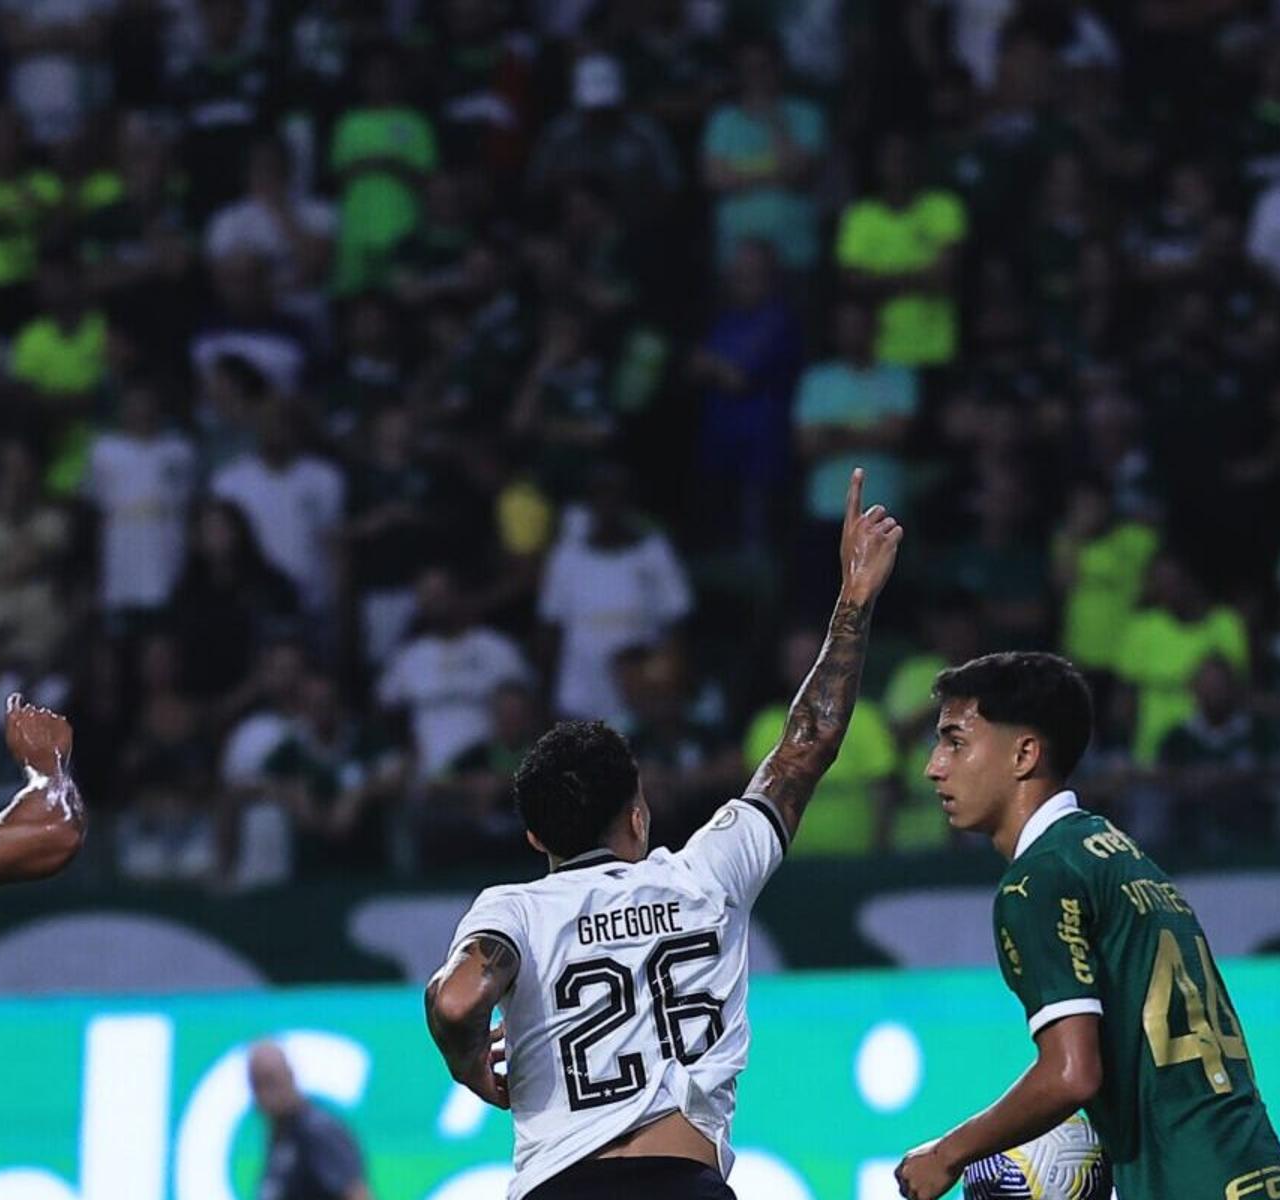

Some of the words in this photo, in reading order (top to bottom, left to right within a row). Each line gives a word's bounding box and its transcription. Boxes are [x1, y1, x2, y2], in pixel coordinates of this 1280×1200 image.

[577, 901, 683, 946] GREGORE
[1057, 898, 1095, 985] crefisa
[554, 930, 725, 1112] 26
[1142, 928, 1258, 1097] 44
